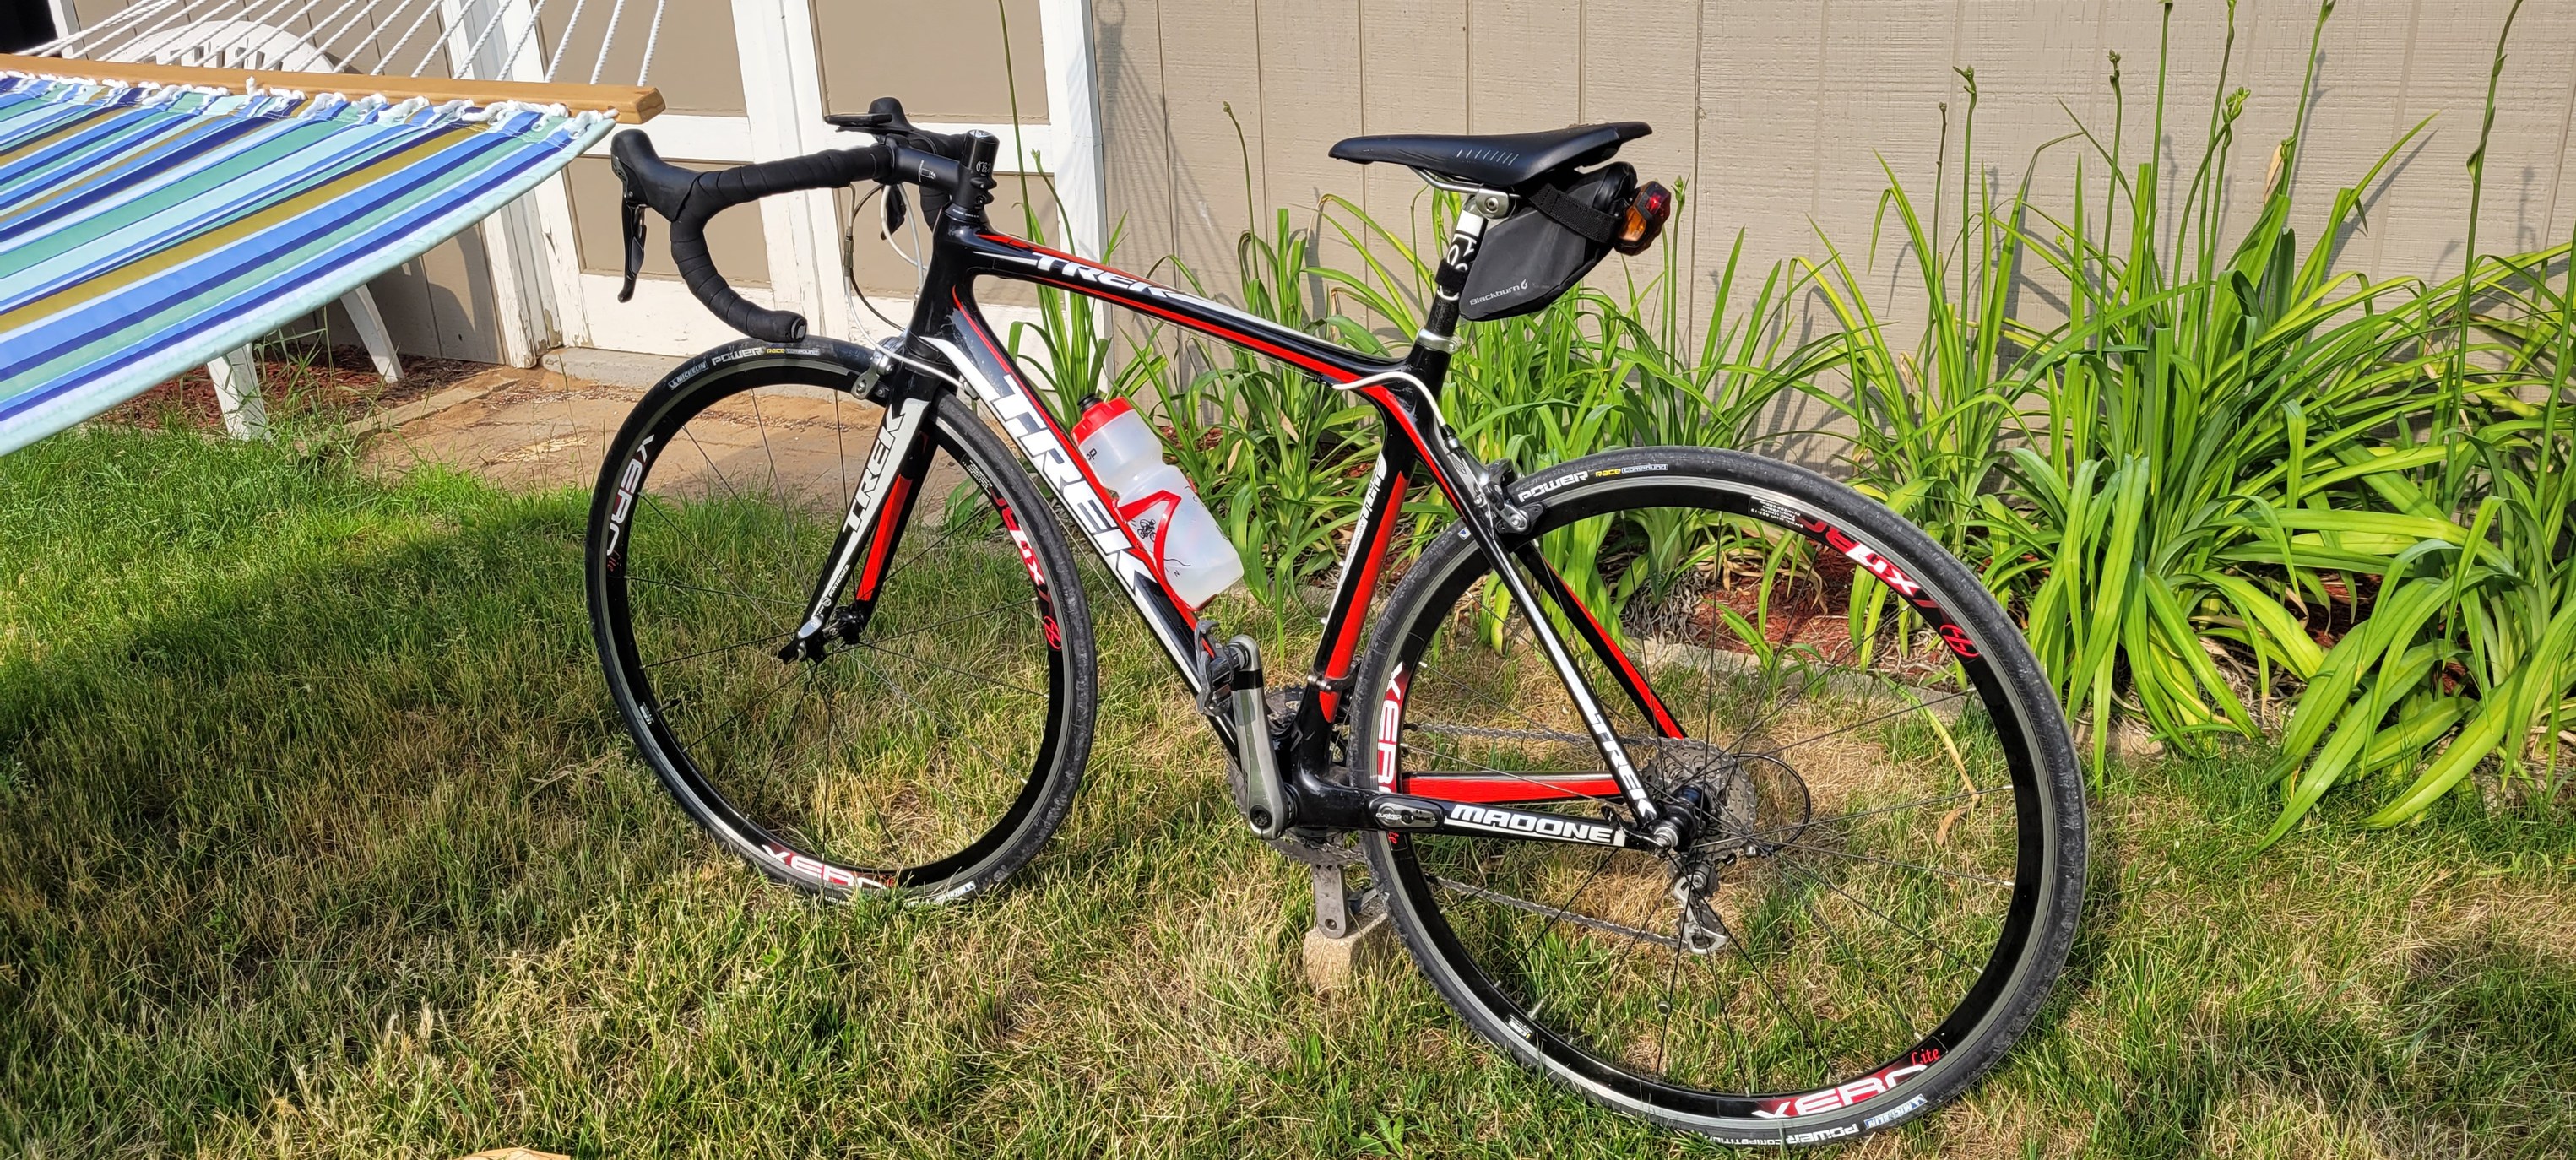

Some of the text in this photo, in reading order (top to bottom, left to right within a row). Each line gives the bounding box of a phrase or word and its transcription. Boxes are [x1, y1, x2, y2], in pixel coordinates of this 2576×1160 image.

[1032, 252, 1177, 298] TREK
[1470, 285, 1520, 306] Blackburn
[676, 362, 708, 383] MICHELIN
[712, 347, 763, 366] POWER
[843, 404, 905, 533] TREK
[990, 375, 1158, 594] TREK
[1518, 471, 1588, 502] POWER
[1378, 662, 1402, 793] XER
[1593, 714, 1657, 817] TREK
[1451, 804, 1613, 843] MADONE
[1911, 1048, 1940, 1067] Lite
[1867, 1099, 1916, 1128] MICHELIN
[1787, 1124, 1859, 1144] POWER
